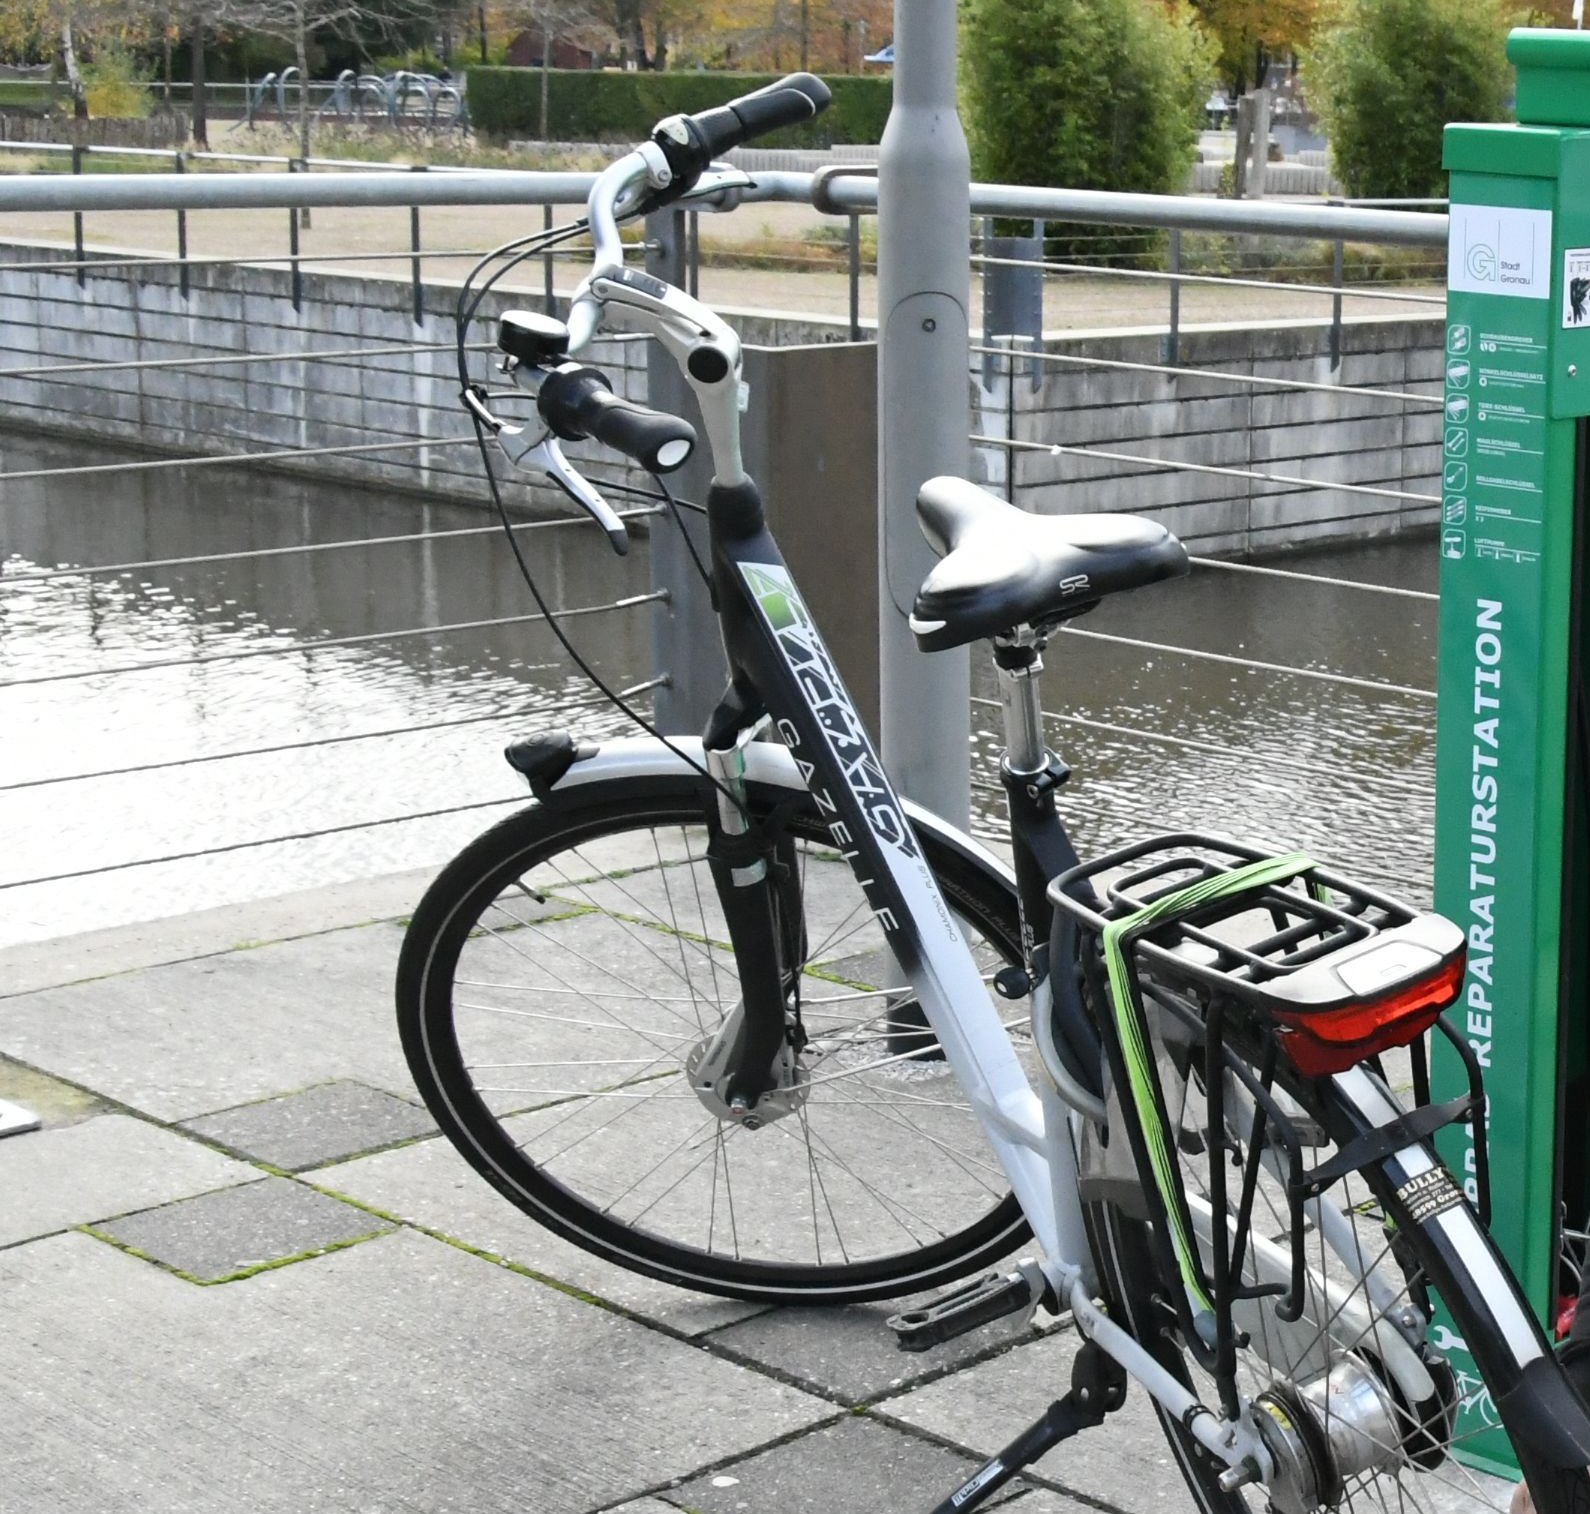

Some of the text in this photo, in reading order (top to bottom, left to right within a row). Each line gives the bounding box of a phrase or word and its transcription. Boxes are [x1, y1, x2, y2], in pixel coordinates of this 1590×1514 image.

[1500, 260, 1521, 271] Stadt
[1500, 274, 1531, 285] Gronau
[776, 717, 900, 933] GAZELLE
[1466, 598, 1503, 1068] REPARATURSTATION
[1396, 1166, 1445, 1201] BULLY
